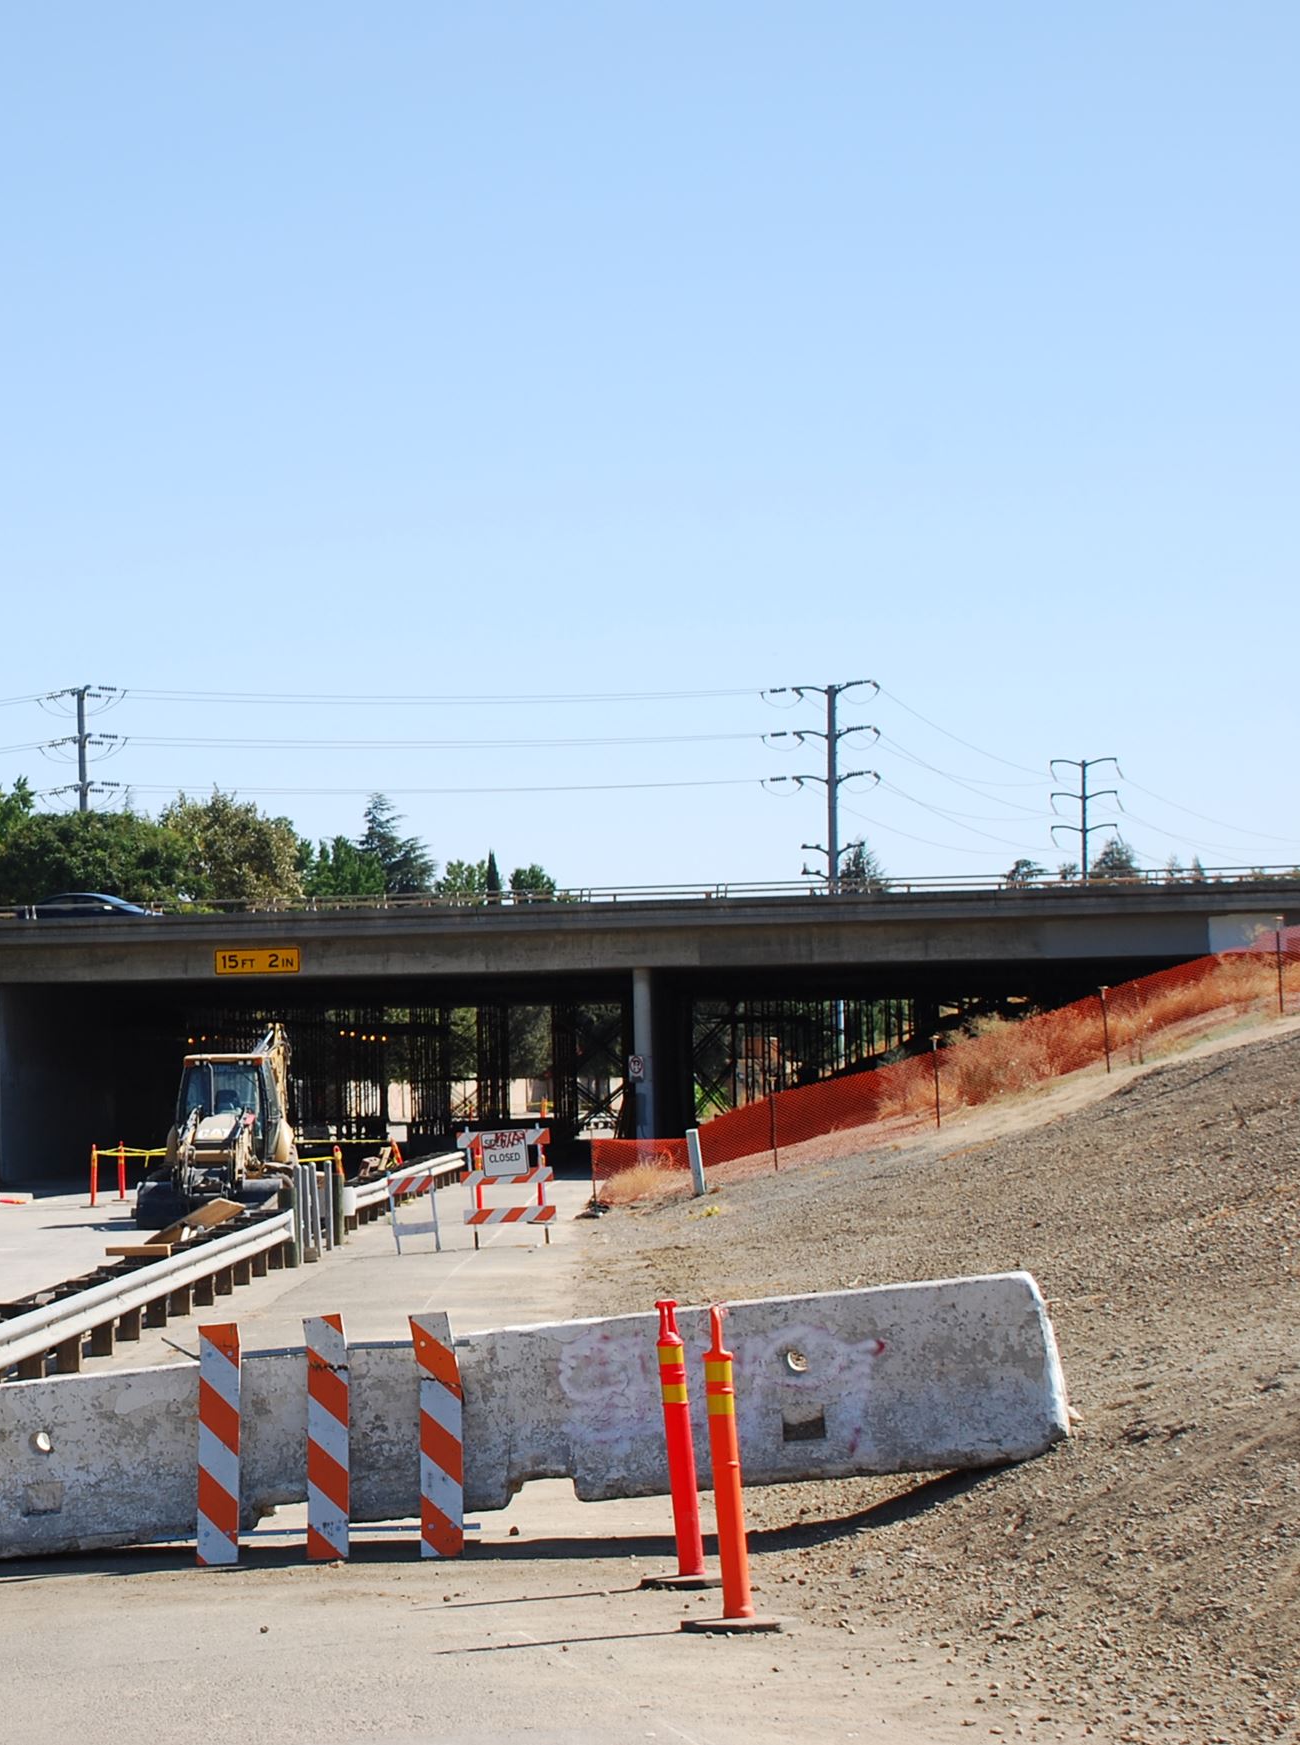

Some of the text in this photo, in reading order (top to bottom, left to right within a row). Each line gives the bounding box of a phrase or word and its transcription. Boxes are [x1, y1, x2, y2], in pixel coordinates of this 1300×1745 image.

[221, 953, 294, 969] 15 FT 2 IN
[488, 1152, 521, 1163] CLOSED
